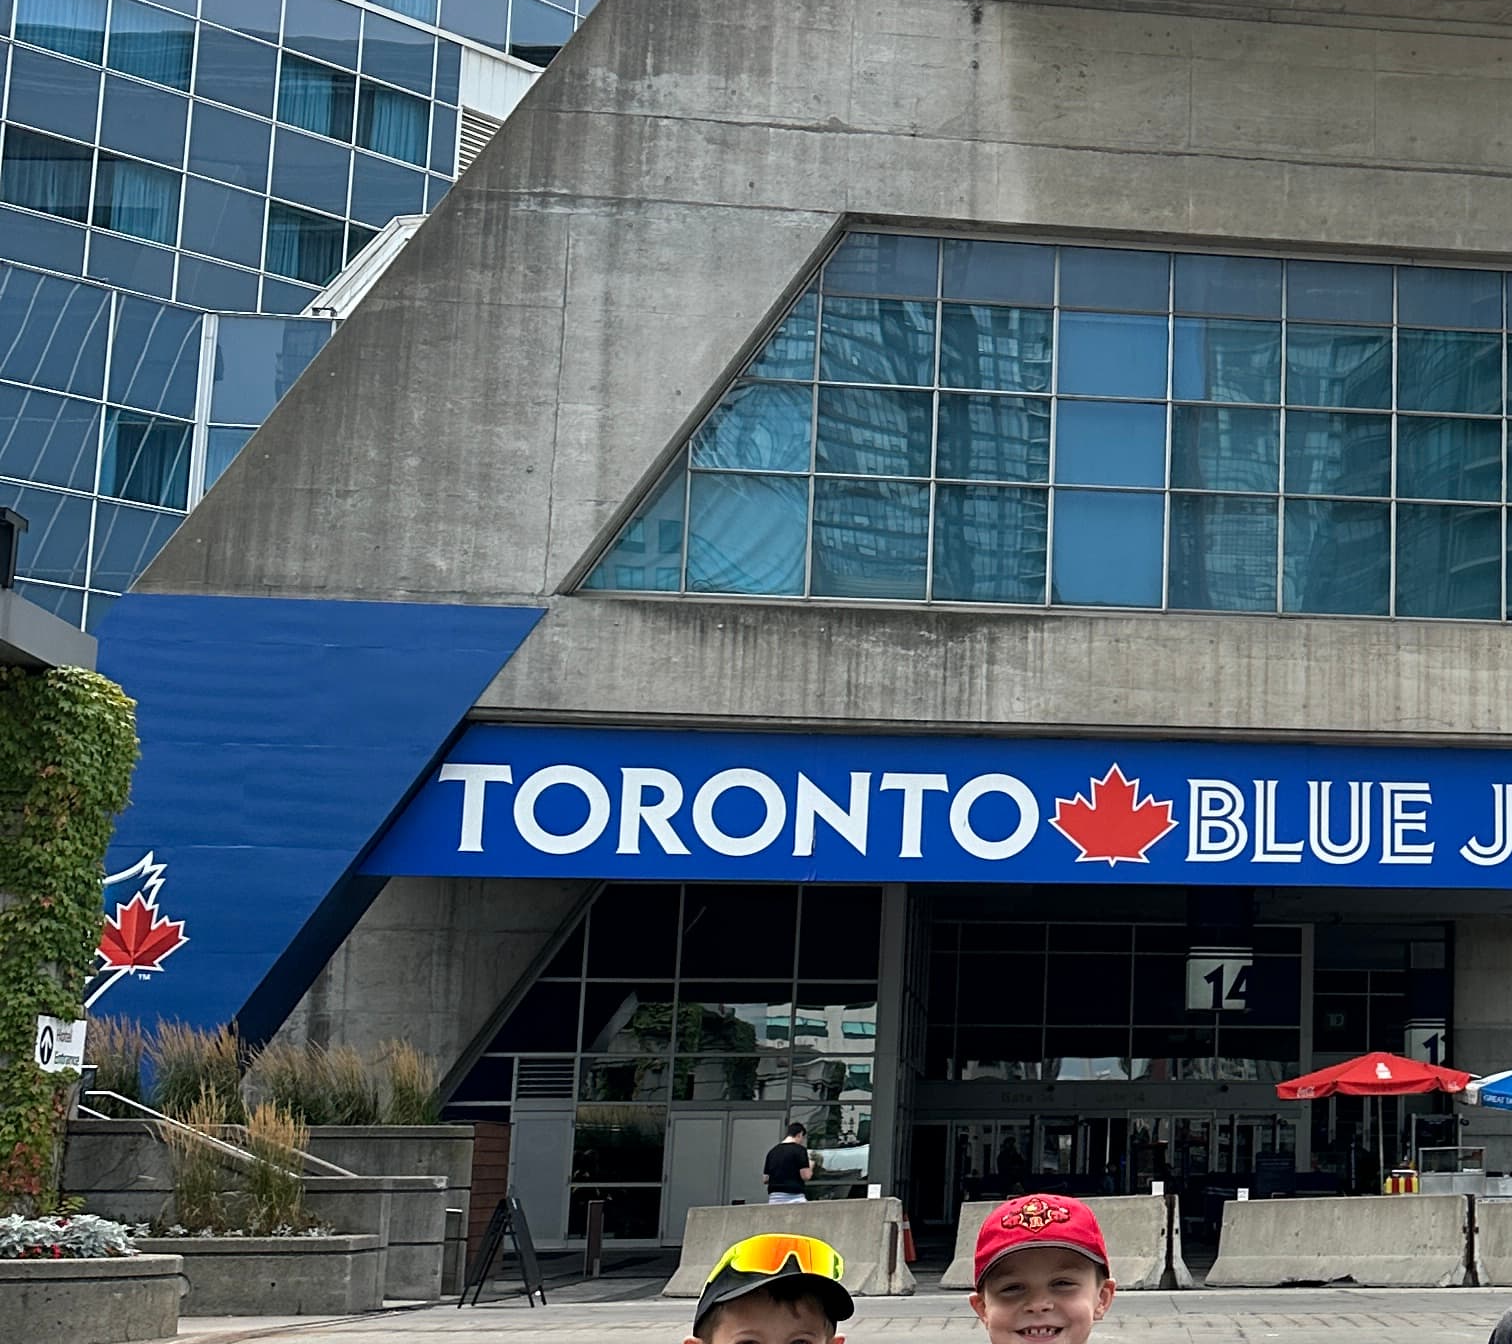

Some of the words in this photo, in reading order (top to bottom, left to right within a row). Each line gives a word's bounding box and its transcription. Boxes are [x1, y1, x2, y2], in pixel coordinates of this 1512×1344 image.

[438, 762, 1040, 861] TORONTO
[1185, 777, 1436, 865] BLUE
[1203, 963, 1249, 1010] 14
